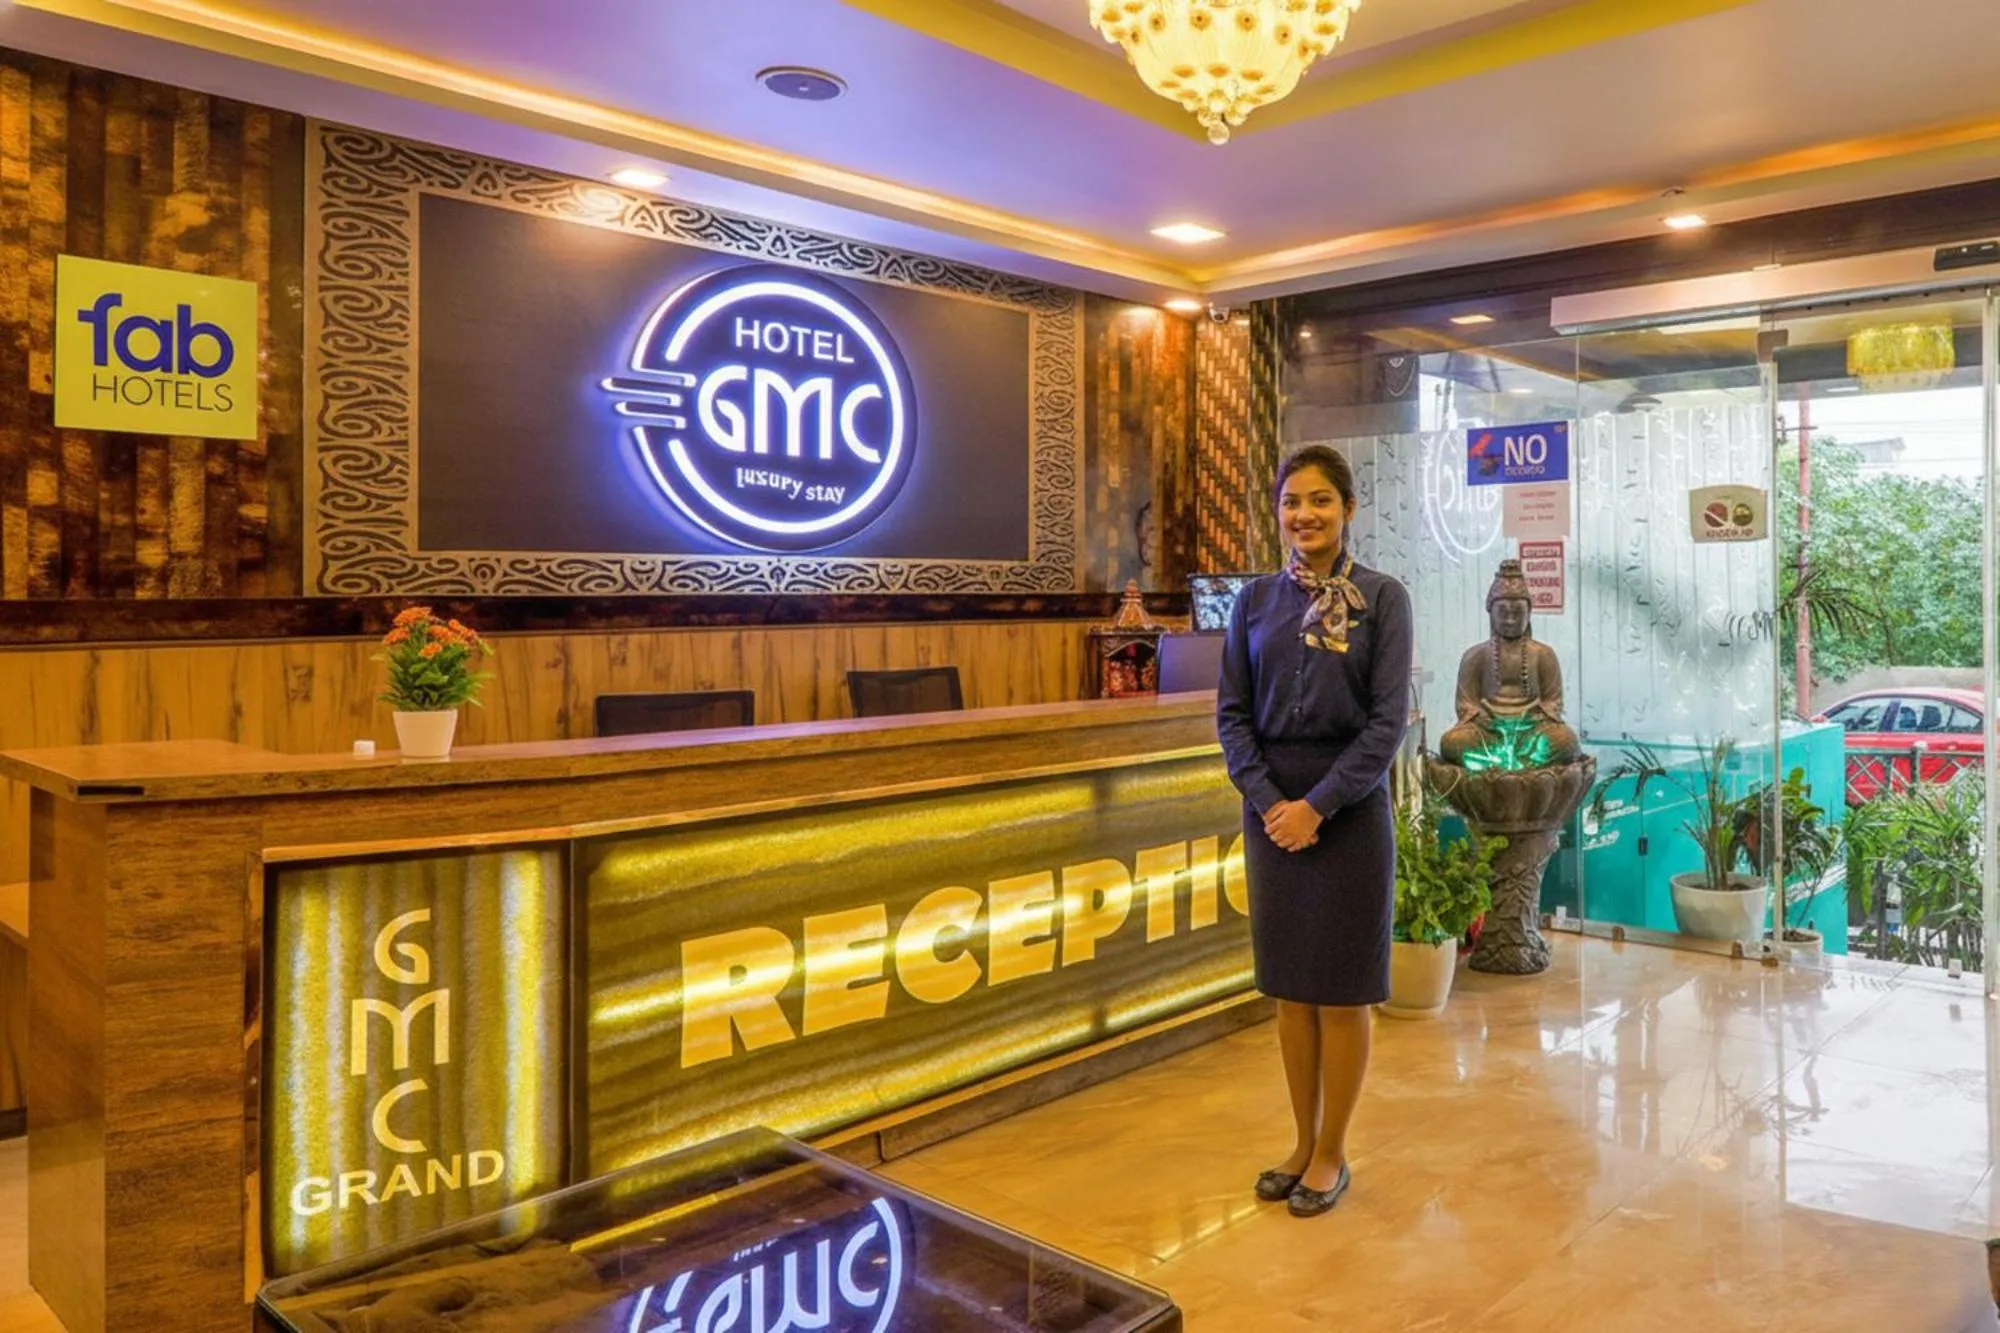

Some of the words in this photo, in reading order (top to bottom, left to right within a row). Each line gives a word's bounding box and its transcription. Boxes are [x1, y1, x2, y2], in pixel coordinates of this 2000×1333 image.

[77, 292, 234, 378] fab
[735, 317, 854, 364] HOTEL
[93, 374, 234, 413] HOTELS
[697, 364, 883, 464] GMC
[1504, 434, 1548, 466] NO
[680, 832, 1249, 1069] RECEPTI
[290, 1149, 505, 1216] GRAND
